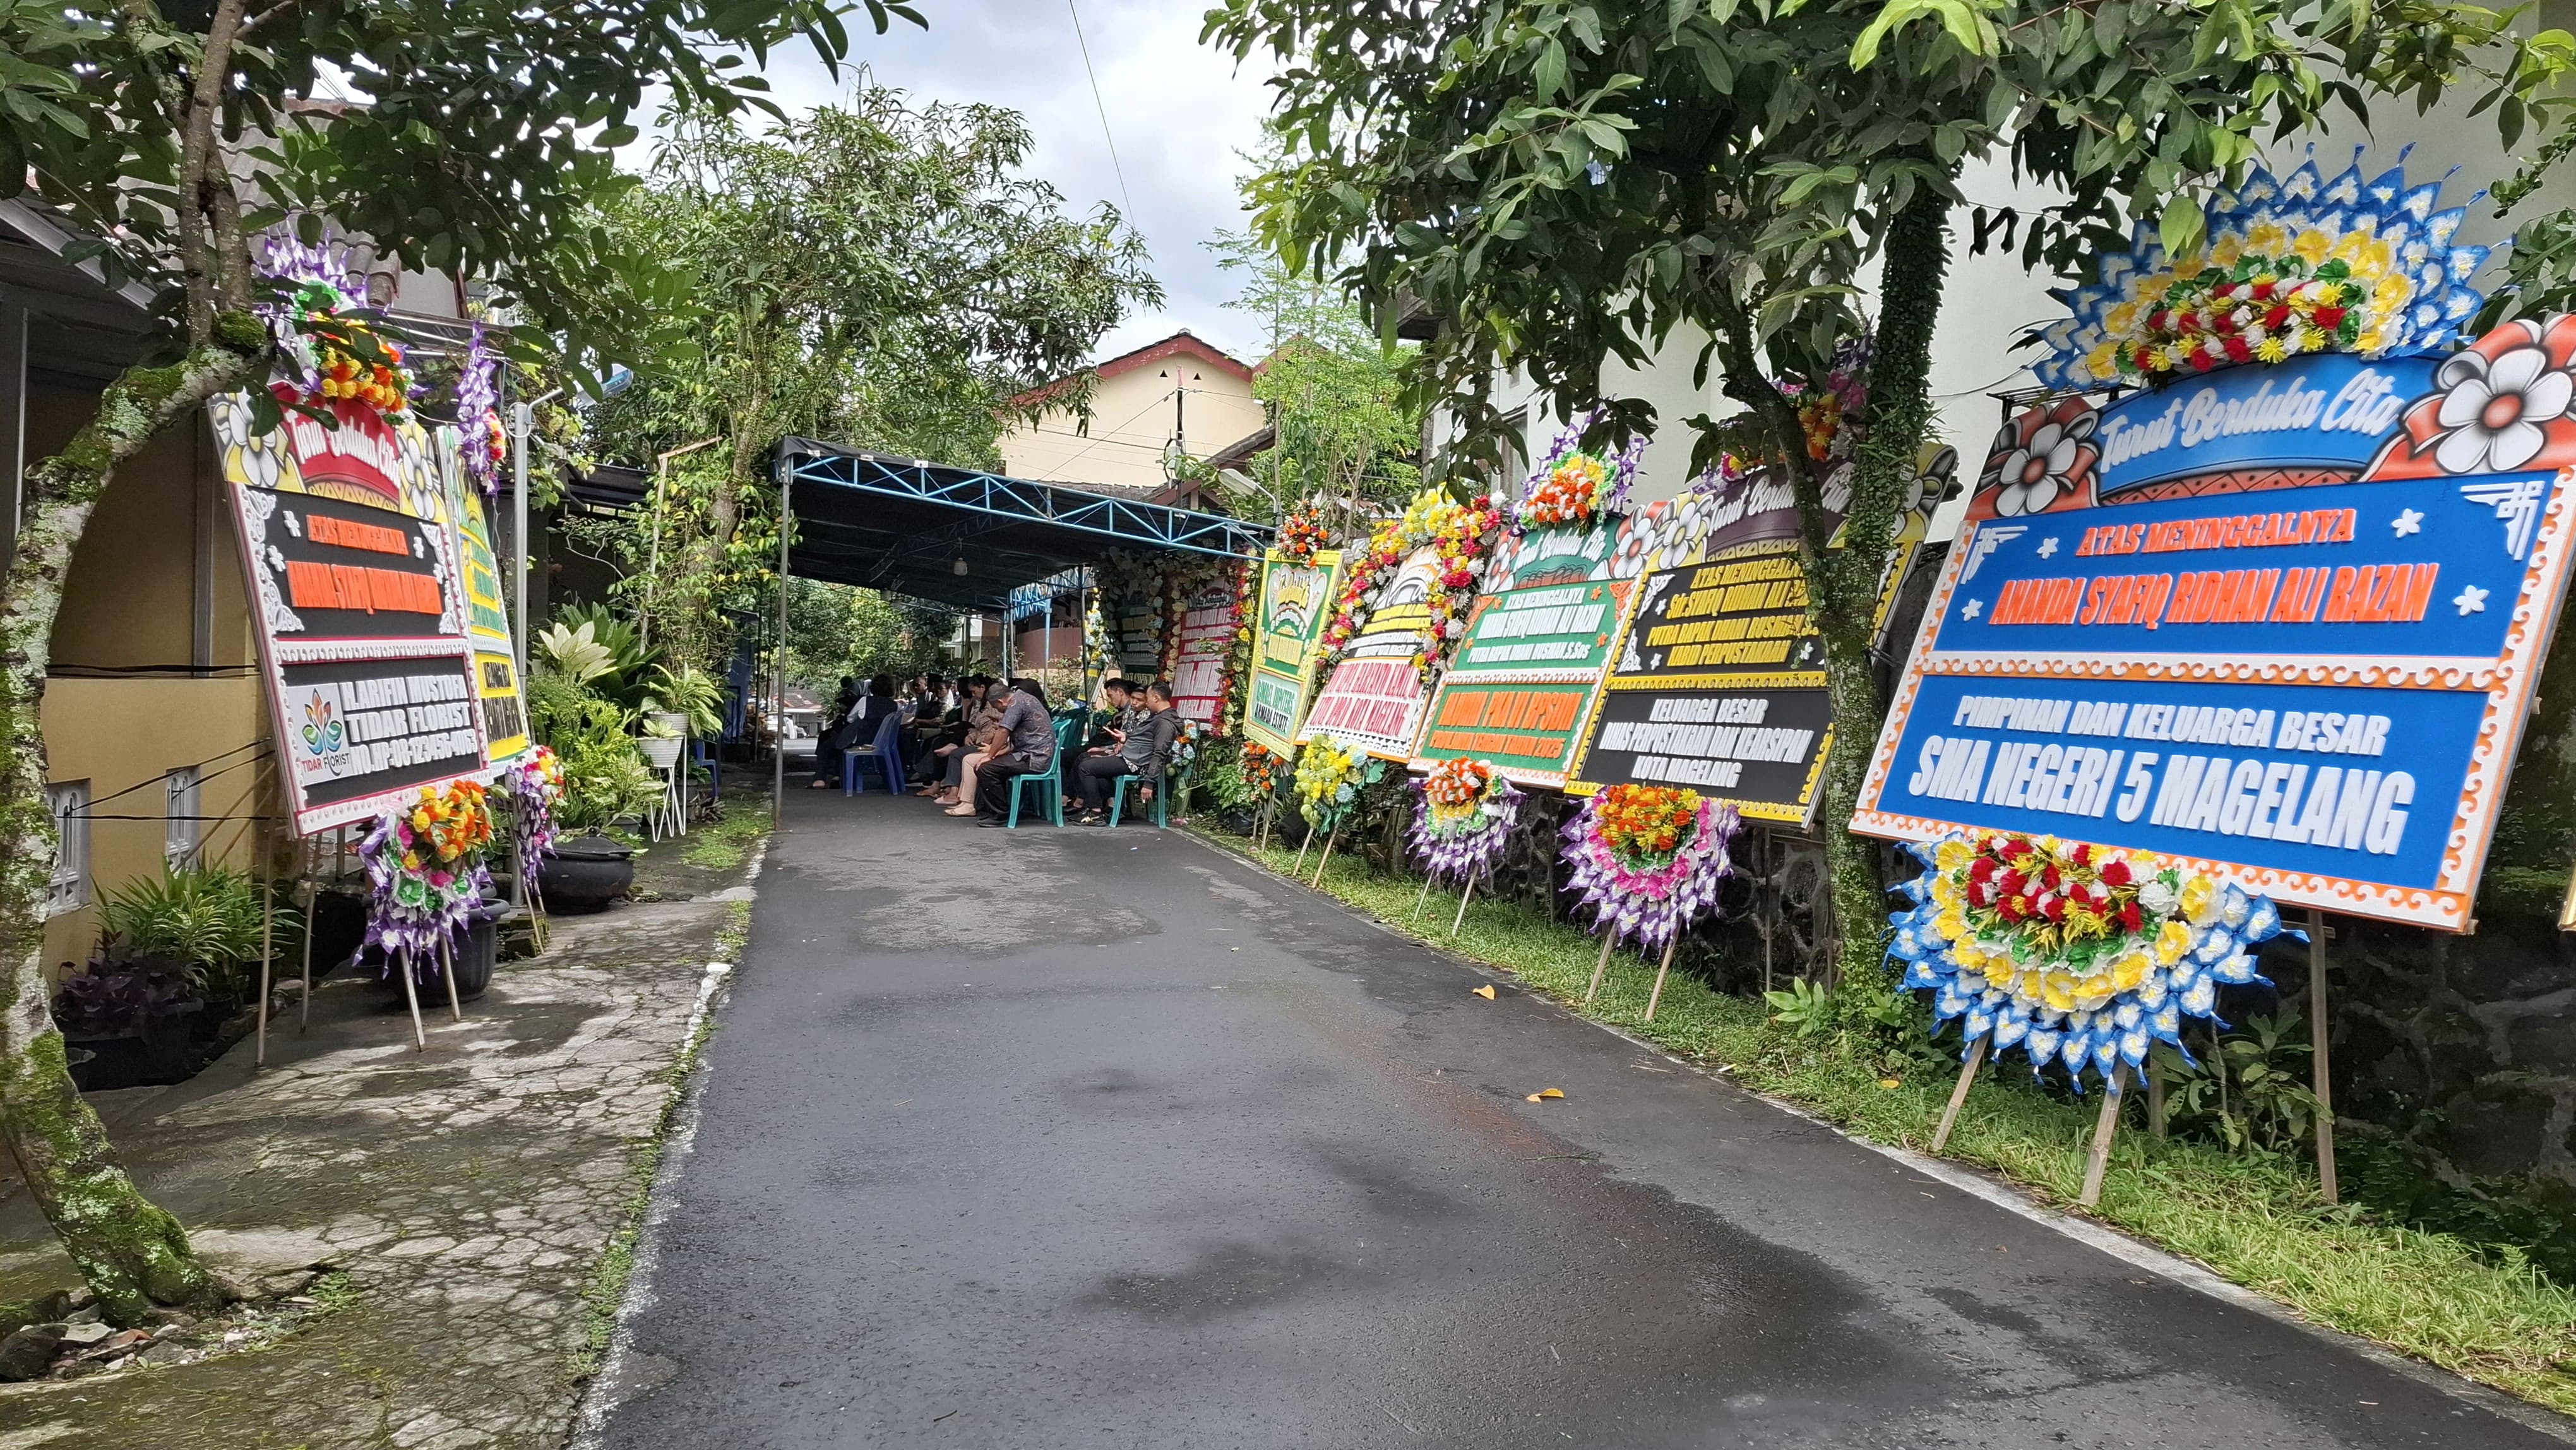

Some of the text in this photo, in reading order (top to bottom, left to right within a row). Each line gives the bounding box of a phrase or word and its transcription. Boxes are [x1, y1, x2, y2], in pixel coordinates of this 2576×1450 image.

[2100, 368, 2405, 473] Turut Berduka Cita
[1708, 485, 1750, 537] Turut
[1513, 525, 1606, 572] Turut Berduka Cita
[2075, 507, 2357, 556] ATAS MENINGGALNYA
[1690, 565, 1723, 589] ATAS
[1504, 587, 1586, 610] ATAS MENINGGALNYA
[1720, 582, 1770, 613] RIDHAN
[1763, 580, 1792, 609] ALI
[1988, 563, 2440, 630] ANANDA SYAFIQ RIDHAN ALI RAZAN
[1646, 624, 1681, 647] PUTRA
[1677, 621, 1716, 644] BAPAK
[1667, 640, 1792, 667] KABID PERPUSTAKAAN
[339, 677, 408, 711] H.ARIFIN
[405, 674, 468, 704] MUSTOFA
[1649, 698, 1769, 724] KELUARGA BESAR
[344, 709, 409, 743] TIDAR
[407, 702, 470, 733] FLORIST
[1255, 702, 1273, 725] ARMADA
[1272, 711, 1289, 734] ESTATE
[1344, 697, 1373, 731] KOTA
[1365, 699, 1410, 736] MAGELANG
[1953, 695, 2392, 757] PIMPINAN DAN KELUARGA BESAR
[1534, 737, 1566, 758] 2025
[1732, 727, 1815, 764] KEARSIPAN
[302, 753, 349, 776] TIDAR FLORIST
[1631, 755, 1743, 788] KOTA MAGELANG
[1909, 735, 2416, 856] SMA NEGERI 5 MAGELANG
